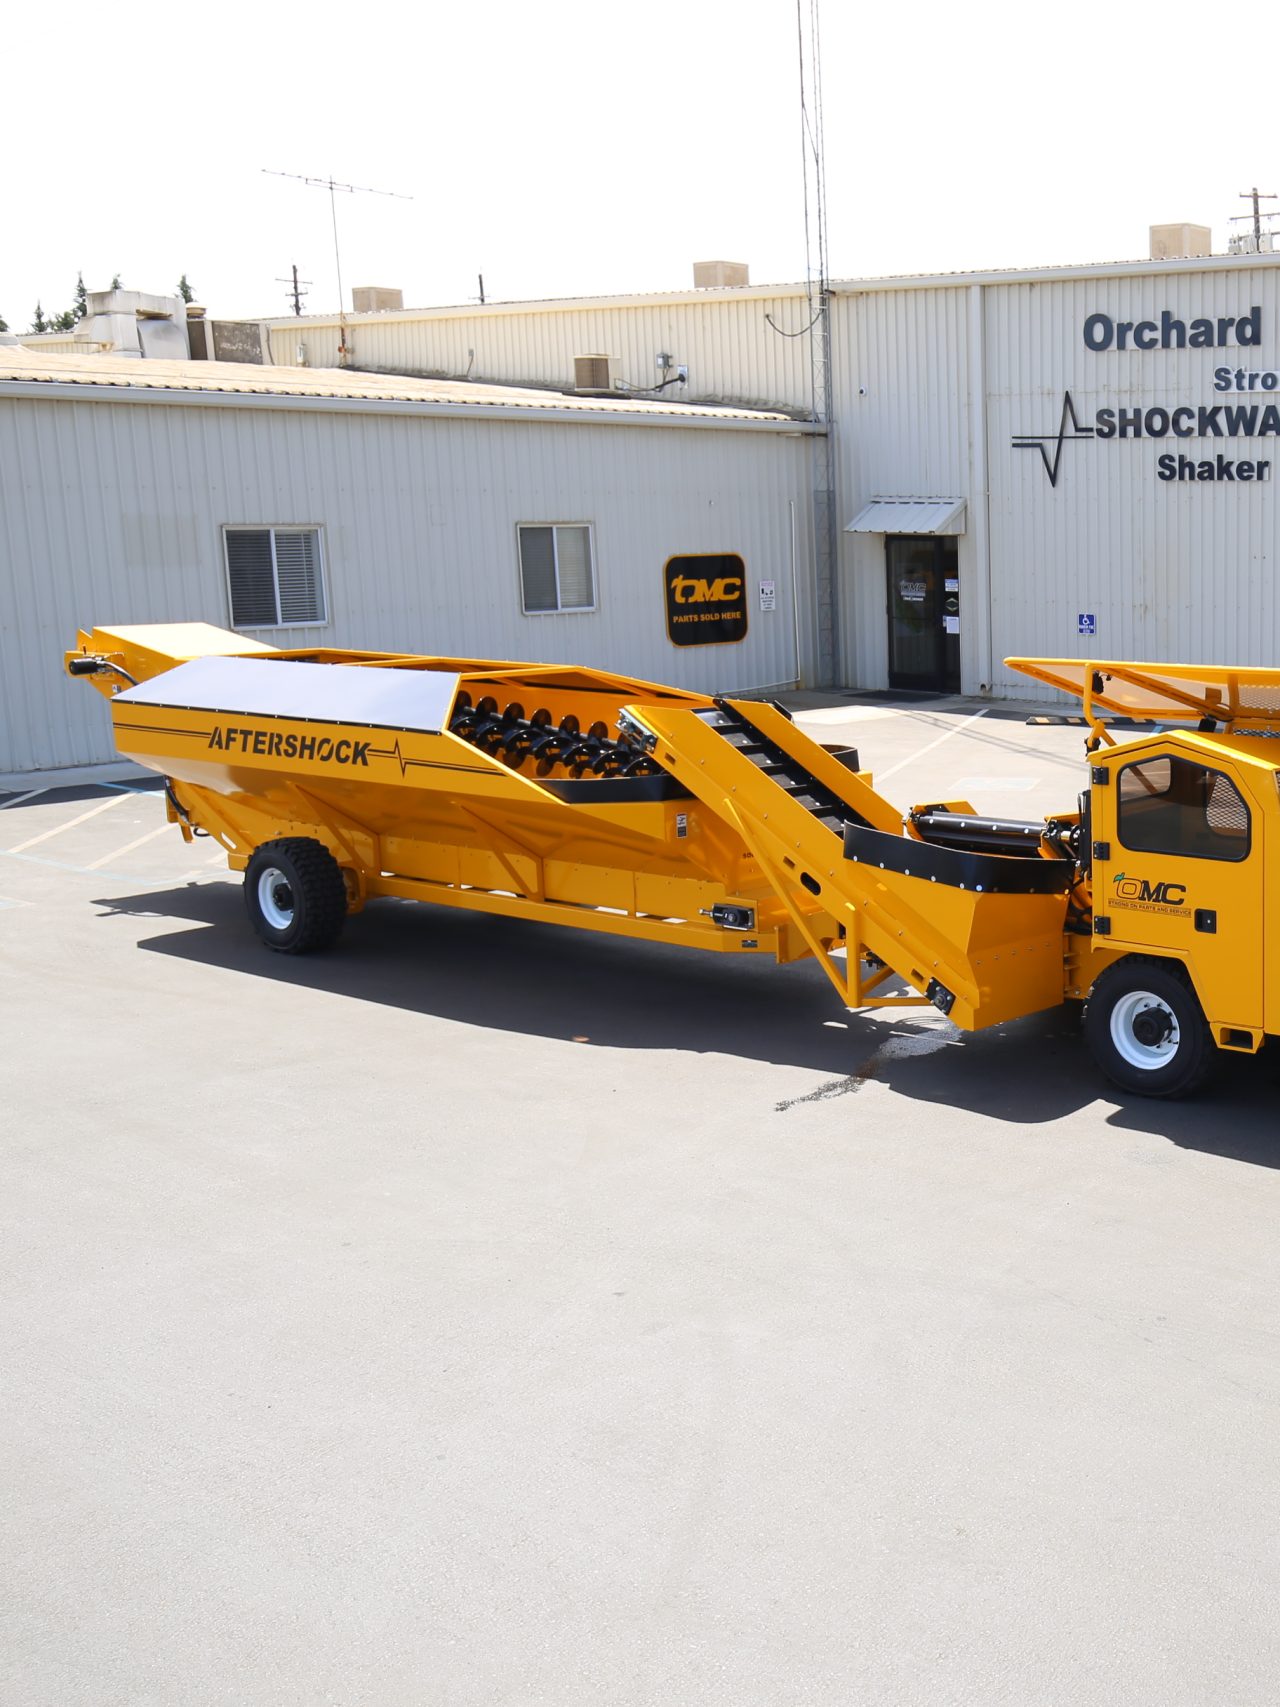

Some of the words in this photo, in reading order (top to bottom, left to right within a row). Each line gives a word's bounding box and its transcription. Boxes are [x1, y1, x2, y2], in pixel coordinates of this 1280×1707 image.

[1083, 307, 1261, 350] Orchard
[1157, 454, 1270, 482] Shaker
[671, 575, 742, 604] OMC
[673, 615, 699, 623] PARTS
[700, 613, 720, 622] SOLD
[721, 611, 742, 620] HERE
[208, 726, 371, 766] AFTERSHOCK
[1116, 876, 1186, 905] OMC
[1108, 899, 1129, 907] STRONG
[1139, 904, 1156, 912] PARTS
[1169, 908, 1191, 916] SERVICE
